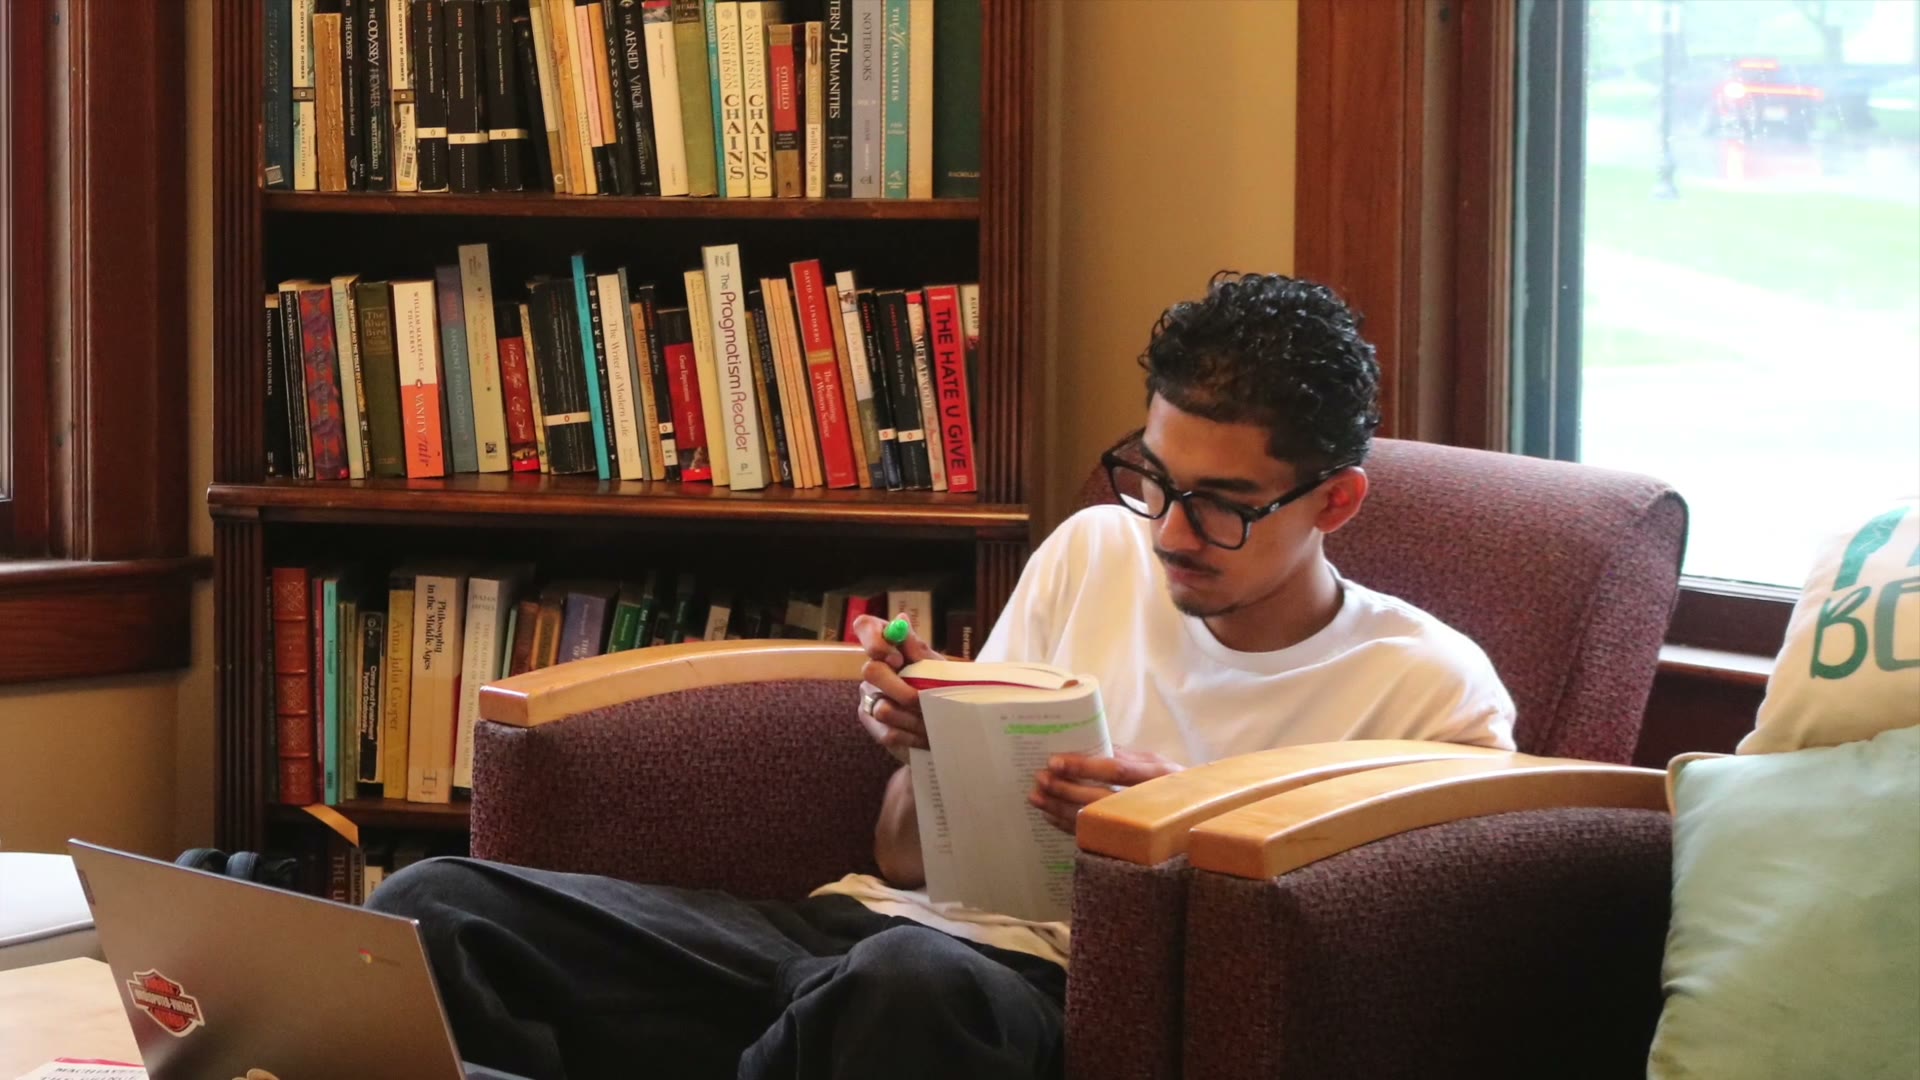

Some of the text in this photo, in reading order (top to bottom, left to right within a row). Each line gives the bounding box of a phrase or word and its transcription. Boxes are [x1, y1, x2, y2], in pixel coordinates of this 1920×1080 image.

[829, 0, 841, 30] TERN
[367, 20, 379, 66] ODYSSEY
[624, 29, 638, 70] AENEID
[720, 25, 732, 89] ANDERSON
[744, 25, 756, 89] ANDERSON
[863, 12, 872, 81] NOTEBOOKS
[888, 24, 906, 101] HUMANITIES
[369, 69, 380, 109] HOMER
[629, 75, 643, 111] VIRGIL
[781, 66, 789, 110] OTHELLO
[829, 33, 848, 119] HUMANITIES
[724, 94, 744, 180] CHAINS
[748, 94, 768, 180] CHAINS
[810, 126, 818, 151] Twelfth
[808, 151, 818, 172] Night
[804, 269, 812, 293] DAVID
[809, 304, 820, 342] LINDBERG
[408, 310, 416, 354] THACKERAY
[590, 289, 605, 375] BECKETT
[609, 321, 617, 338] The
[936, 308, 953, 345] THE
[416, 327, 425, 371] MAKEPEACE
[611, 341, 621, 369] Writer
[679, 354, 687, 368] Great
[719, 274, 751, 453] The Pragmatism Reader
[908, 304, 933, 409] MARGARET ATWOOD
[615, 371, 621, 381] of
[816, 381, 827, 412] Western
[823, 370, 836, 423] The Beginnings
[939, 352, 960, 400] HATE
[415, 393, 427, 434] VANITY
[617, 383, 626, 417] Modern
[945, 405, 961, 419] U
[620, 419, 628, 437] Life
[821, 414, 830, 438] Science
[948, 423, 968, 470] GIVE
[427, 595, 435, 611] the
[425, 613, 435, 647] Middle
[436, 600, 447, 653] Philosophy
[388, 619, 404, 731] Anna Julia Cooper
[422, 648, 432, 671] Ages
[368, 702, 376, 740] Punishment
